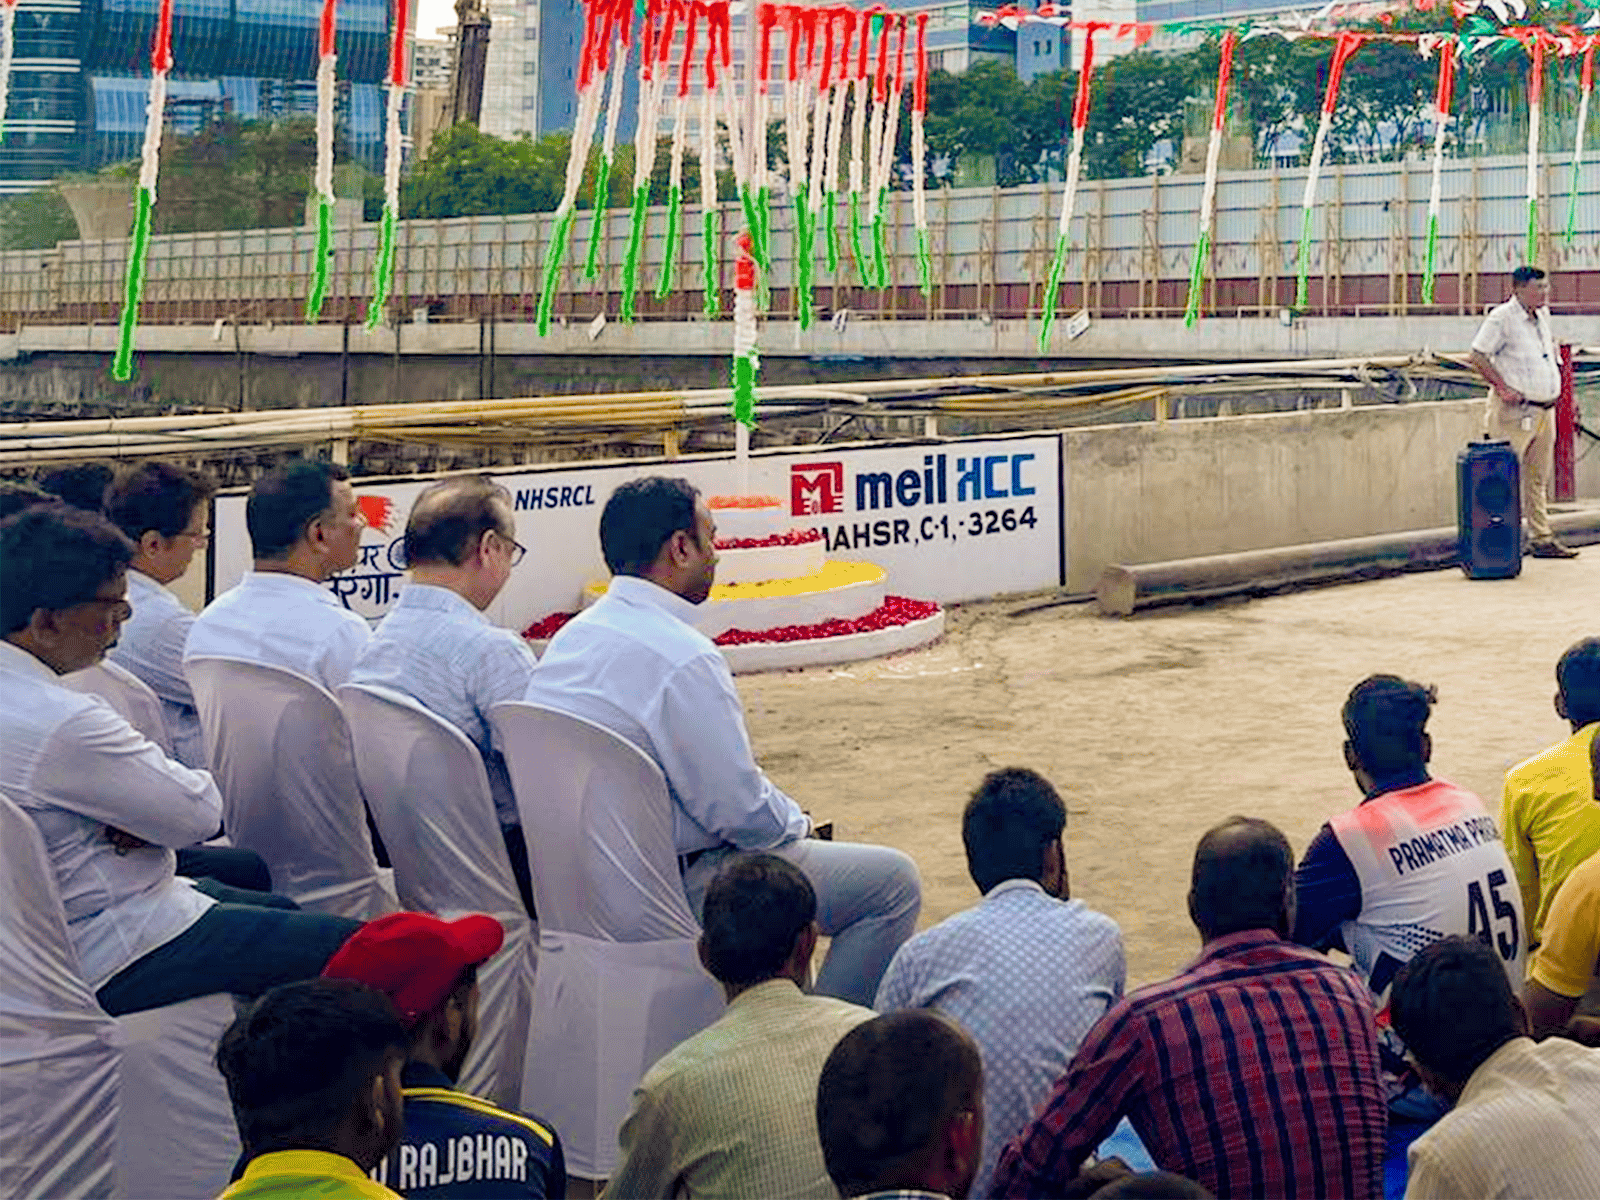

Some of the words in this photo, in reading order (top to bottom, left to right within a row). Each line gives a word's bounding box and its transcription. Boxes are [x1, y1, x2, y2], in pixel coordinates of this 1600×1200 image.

[514, 485, 595, 511] NHSRCL
[856, 454, 947, 511] meil
[1388, 823, 1475, 876] PRAMATMA
[1467, 868, 1519, 961] 45
[400, 1133, 529, 1190] RAJBHAR
